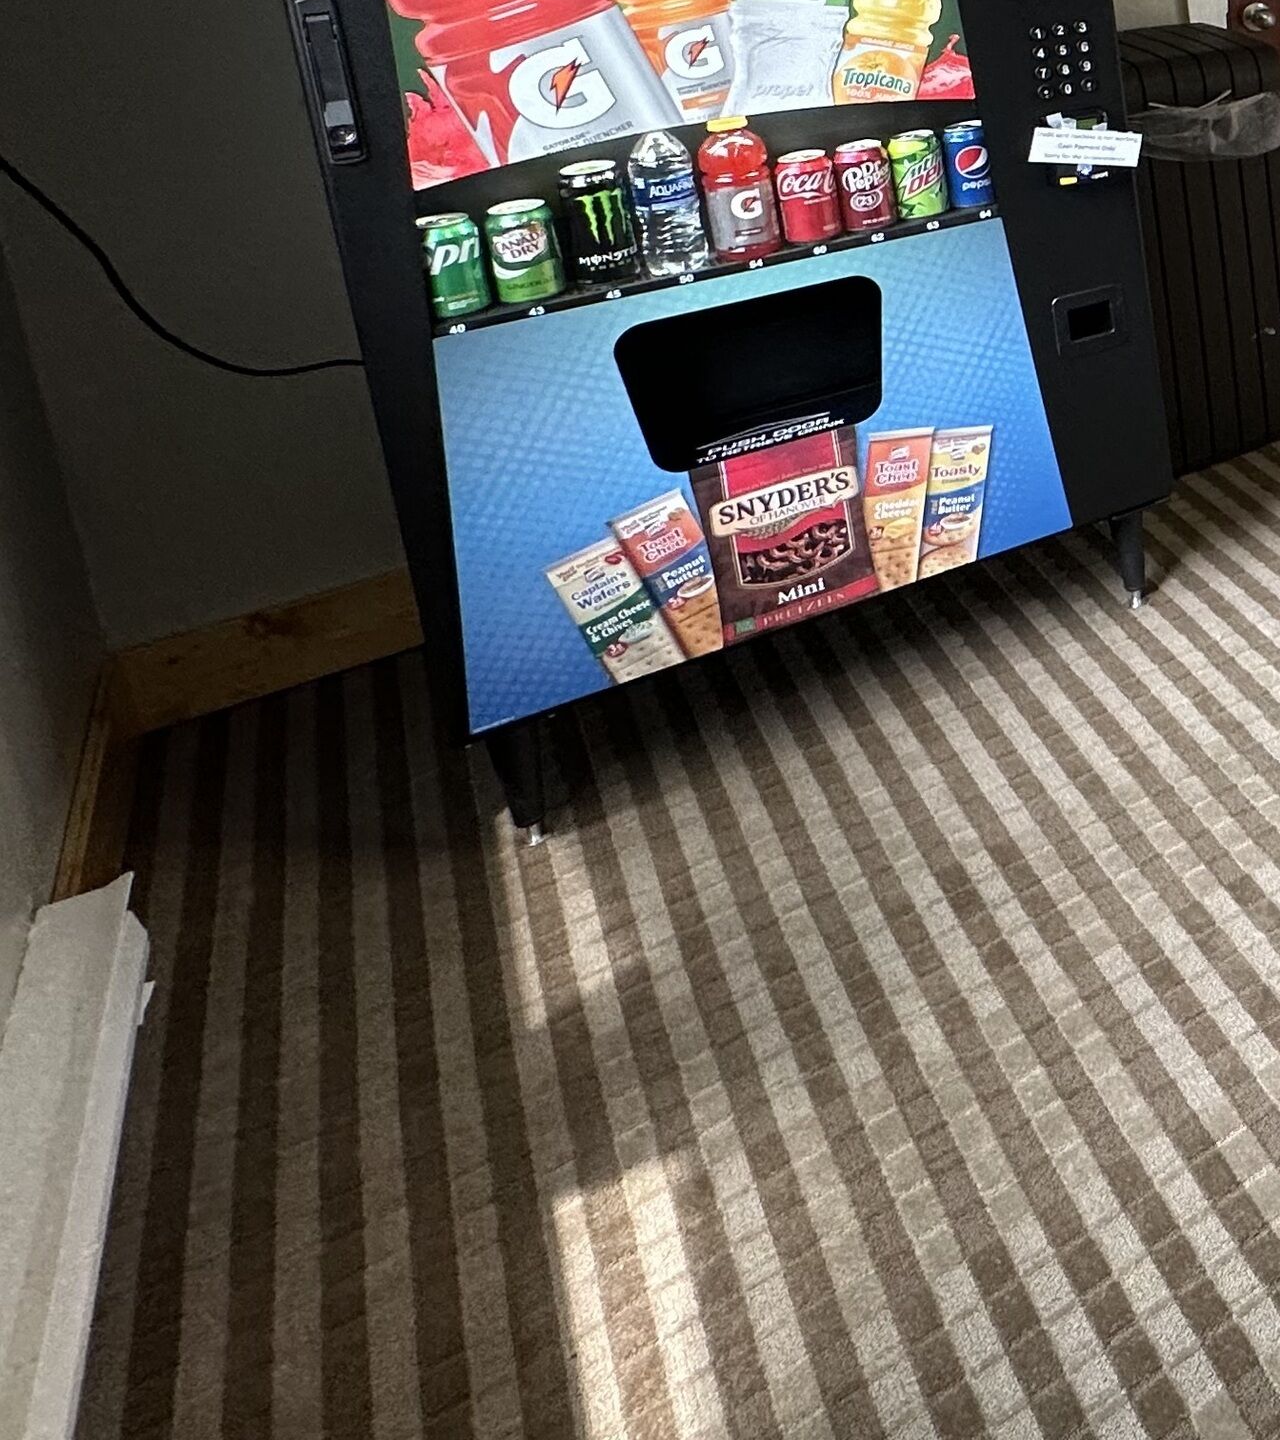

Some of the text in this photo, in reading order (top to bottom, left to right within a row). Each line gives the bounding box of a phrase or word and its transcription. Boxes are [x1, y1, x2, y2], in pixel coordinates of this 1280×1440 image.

[1035, 21, 1087, 39] 1 2 3
[664, 24, 726, 80] G
[1037, 41, 1090, 59] 4 5 6
[843, 67, 912, 95] Tropicana
[1040, 60, 1092, 79] 7 8 9
[508, 37, 618, 130] G
[1064, 83, 1072, 95] 0
[862, 160, 882, 177] Dr
[730, 187, 763, 220] G
[493, 231, 545, 256] CANAD
[510, 242, 540, 259] DRY
[706, 416, 830, 456] PUSH DOOR
[696, 453, 717, 464] TO
[878, 460, 918, 474] Toast
[931, 463, 982, 479] Toasty
[718, 470, 850, 526] SNYDER'S
[938, 503, 971, 515] Butter
[939, 493, 976, 506] Peanut
[749, 497, 827, 526] OF HANOVER
[661, 554, 706, 581] Peanut
[666, 564, 706, 590] Butter
[571, 569, 628, 602] Captain's
[576, 580, 632, 610] Wafers
[777, 577, 826, 605] Mini
[585, 614, 619, 636] Cream
[617, 599, 652, 620] Cheese
[601, 618, 634, 638] Chives
